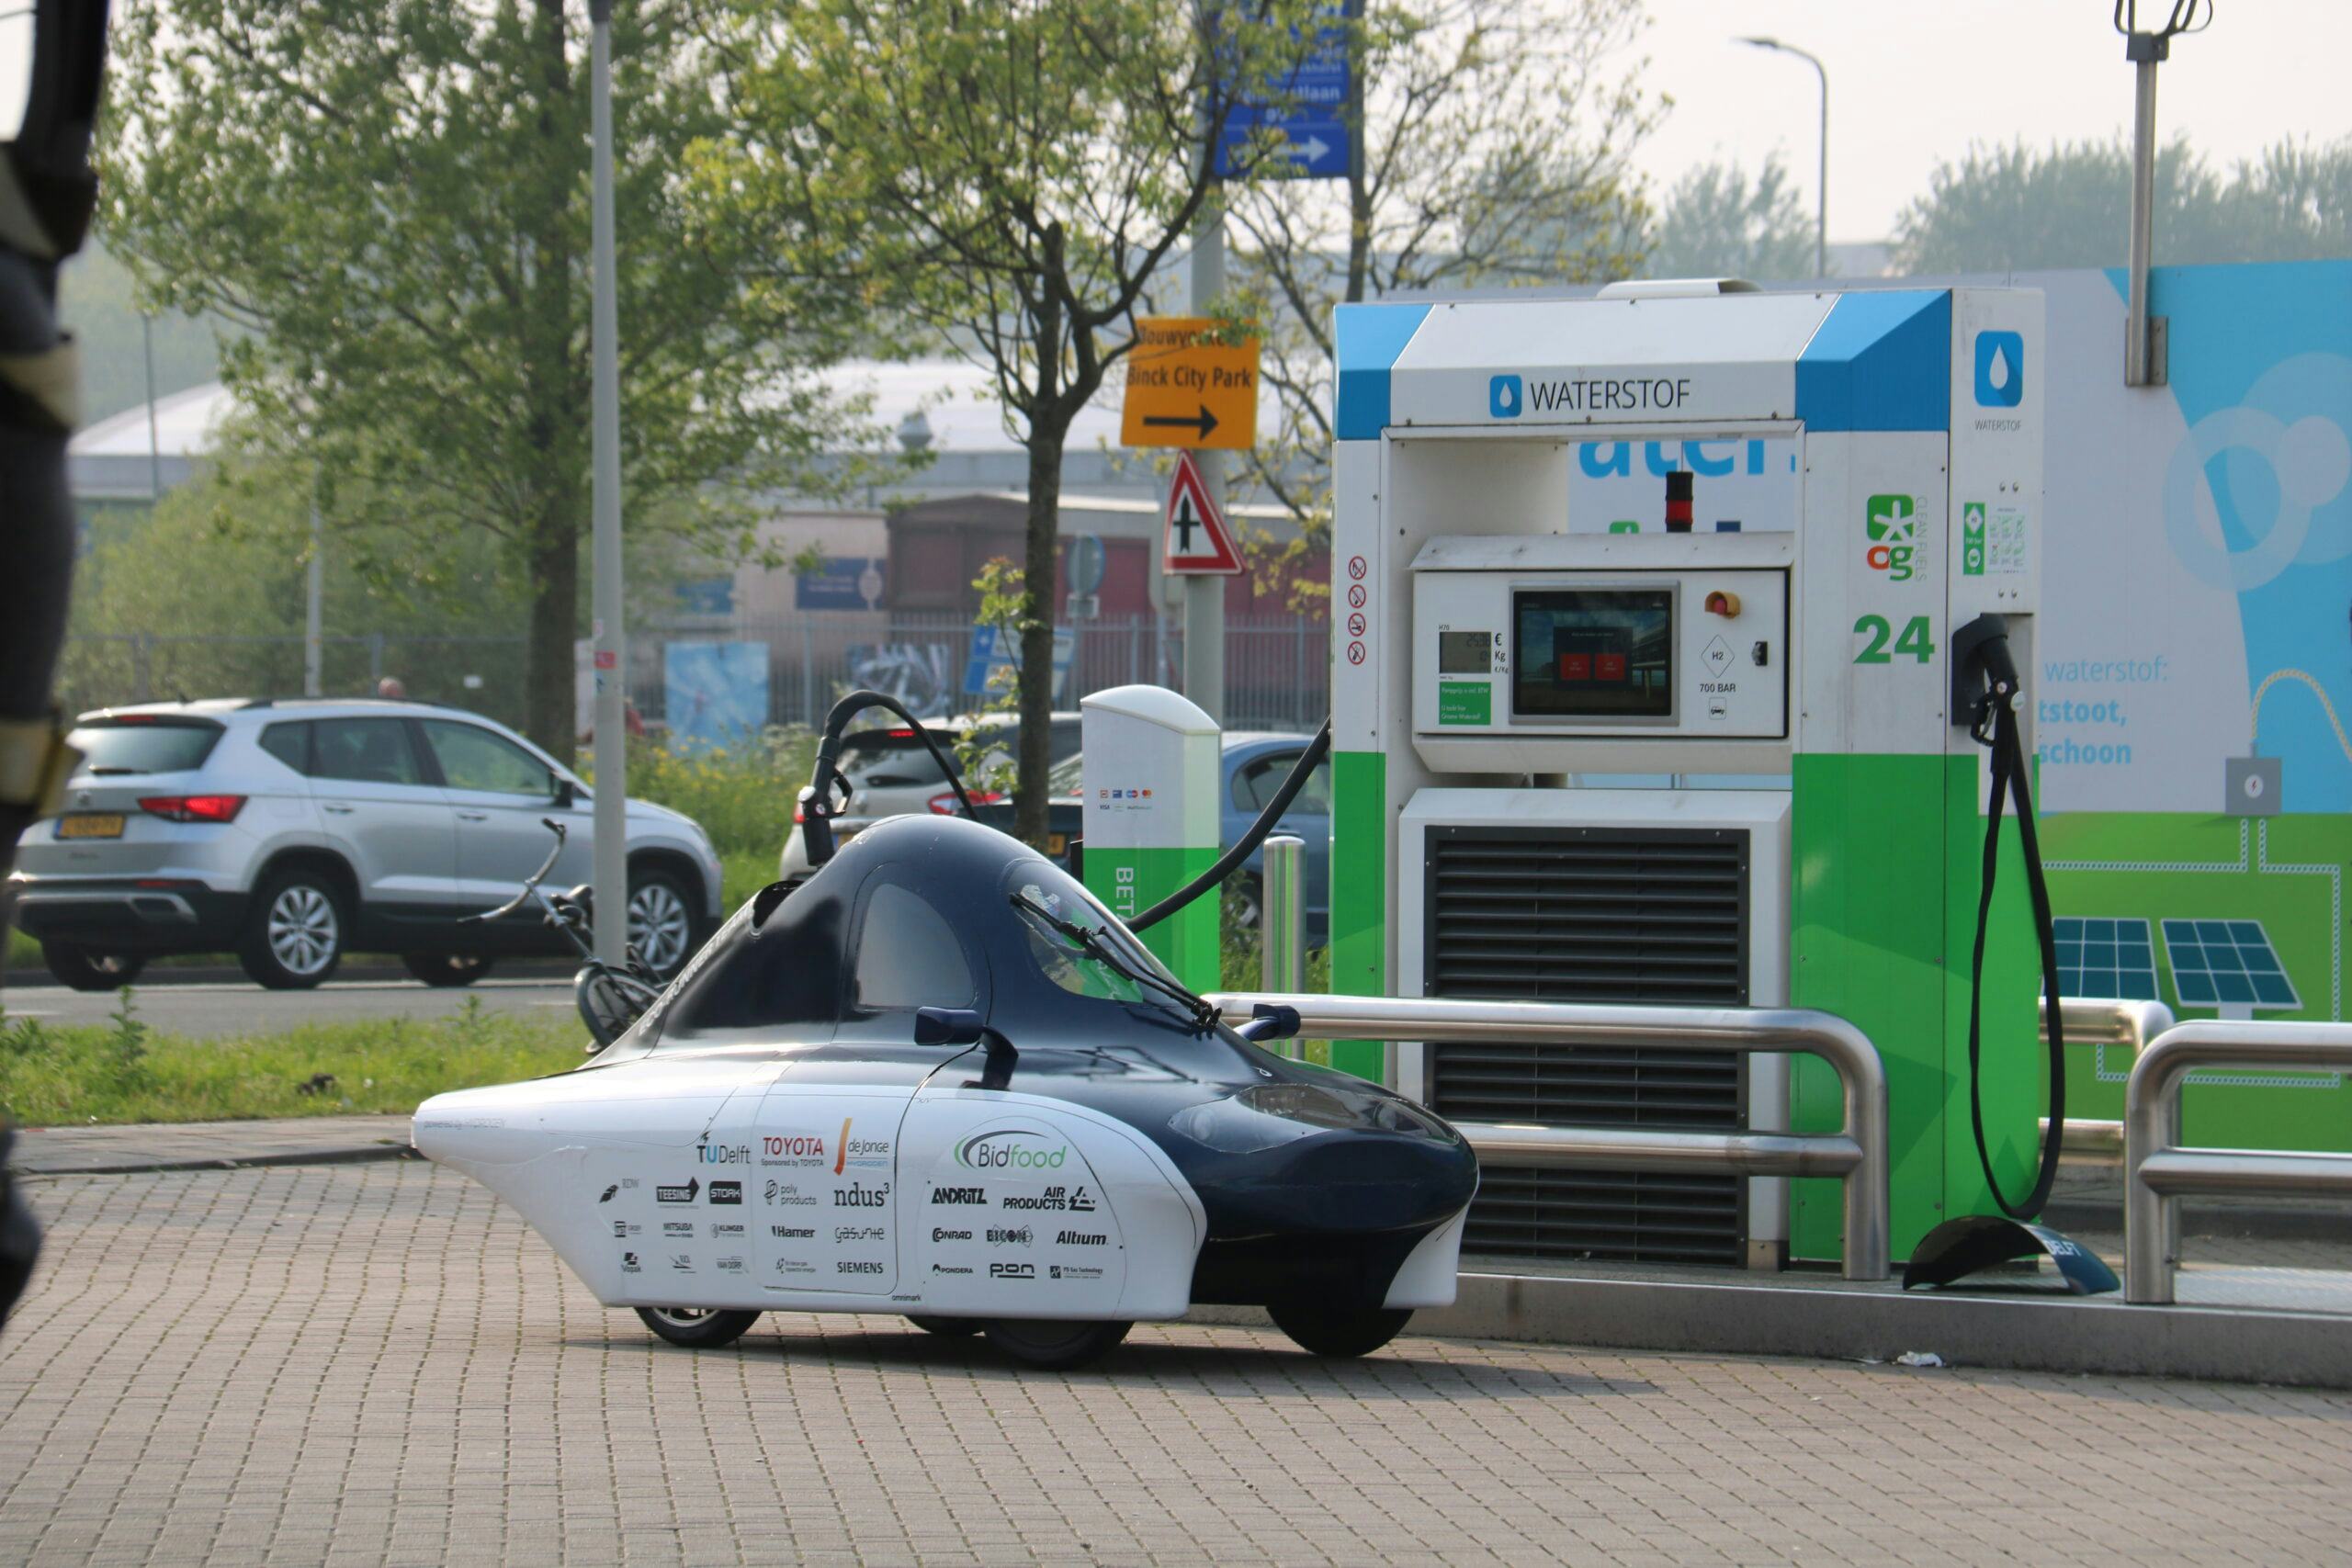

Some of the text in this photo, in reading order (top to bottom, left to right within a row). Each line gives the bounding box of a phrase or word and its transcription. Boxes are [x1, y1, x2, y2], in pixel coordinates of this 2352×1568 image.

[1127, 365, 1251, 393] Binck City Park
[1531, 378, 1690, 412] WATERSTOF
[1495, 632, 1502, 647] €
[1852, 614, 1936, 665] 24
[1495, 649, 1506, 662] Kg
[1712, 651, 1724, 660] H2
[2044, 655, 2168, 682] waterstof:
[1700, 683, 1736, 693] 700 BAR
[763, 1137, 824, 1156] TOYOTA
[761, 1157, 824, 1168] Sponsored by TOYOTA
[978, 1144, 1067, 1168] Bidfood
[658, 1189, 691, 1201] TEESING
[781, 1184, 797, 1195] poly
[931, 1188, 988, 1204] ANDRITZ
[1043, 1187, 1066, 1198] AIR
[781, 1195, 817, 1206] products
[1002, 1197, 1066, 1210] PRODUCTS
[777, 1226, 816, 1238] Hamer
[932, 1227, 972, 1243] CONRAD
[1056, 1230, 1107, 1246] Altium
[837, 1260, 883, 1274] SIEMENS
